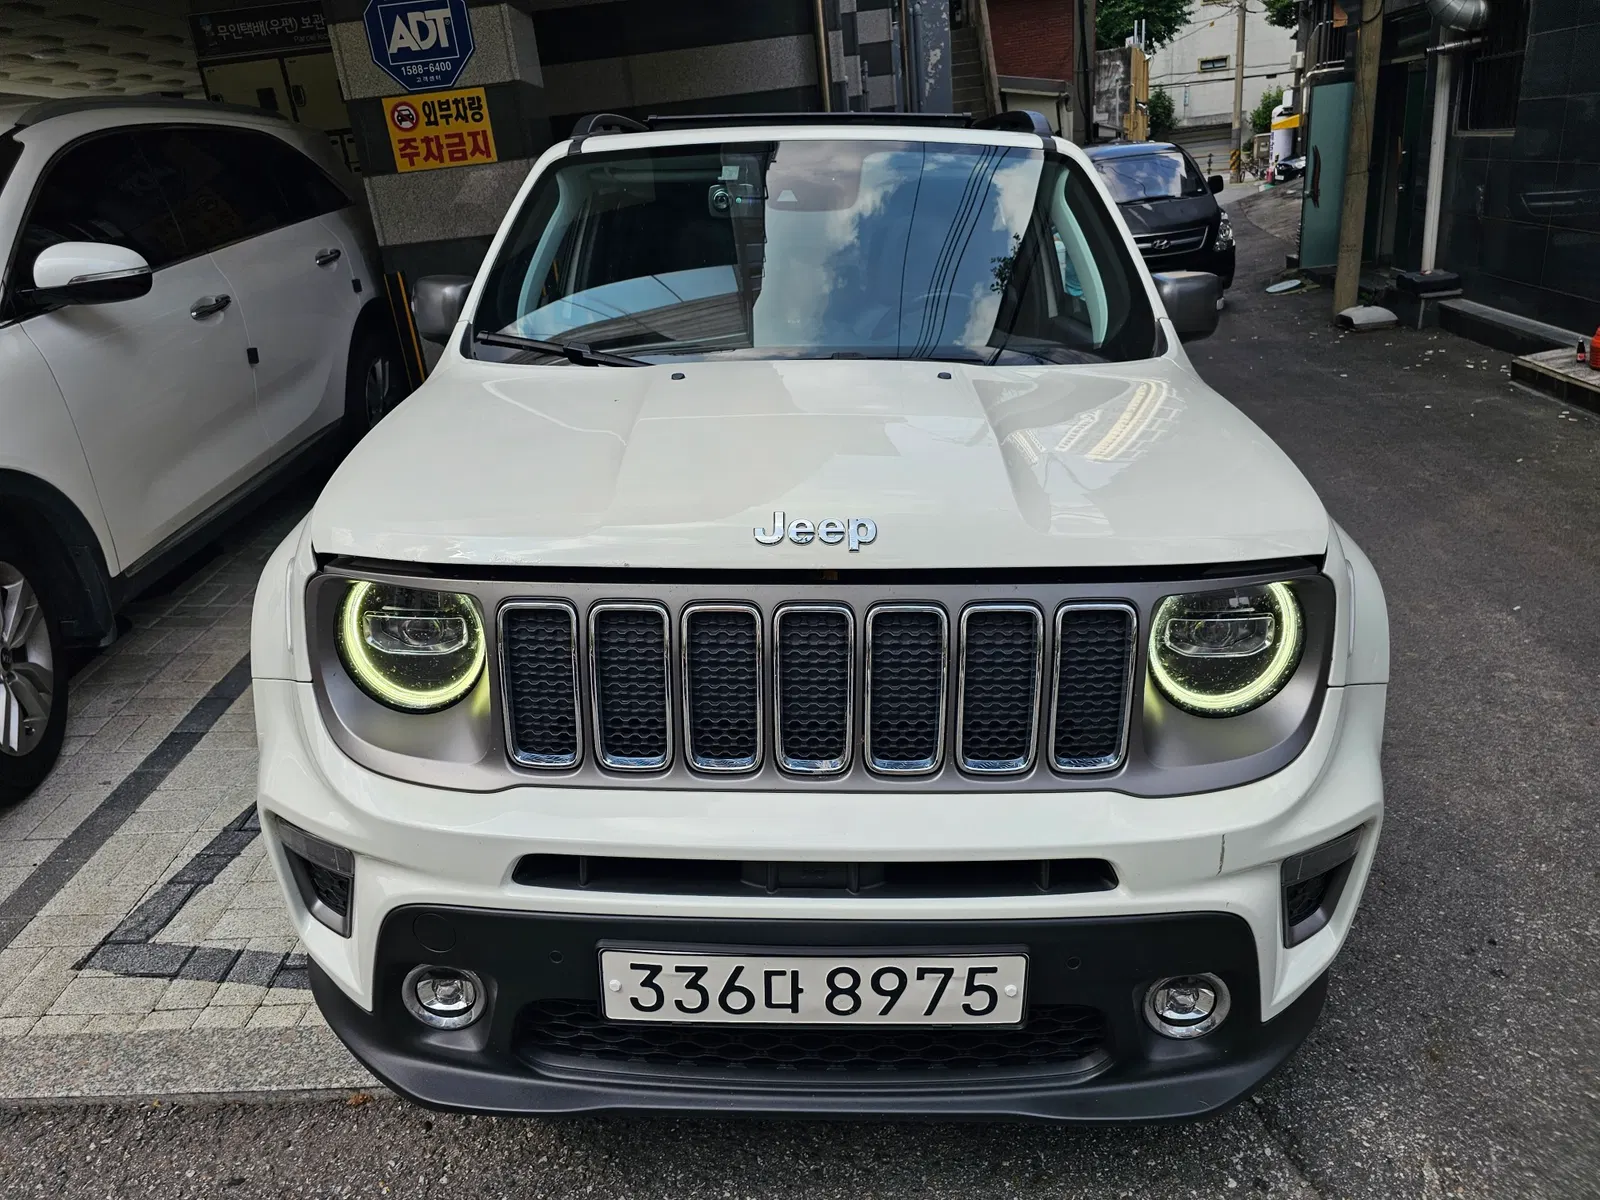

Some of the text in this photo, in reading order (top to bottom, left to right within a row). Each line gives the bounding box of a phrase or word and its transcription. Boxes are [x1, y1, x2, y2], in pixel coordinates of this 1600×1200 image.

[216, 17, 298, 41] 무인택배(우편)
[388, 8, 451, 54] ADT
[401, 61, 452, 76] 1588-6400
[416, 74, 442, 83] 고객센터
[421, 95, 484, 127] 외부차량
[397, 129, 492, 167] 주차금지
[753, 511, 877, 553] Jeep
[629, 962, 999, 1017] 336다 8975
